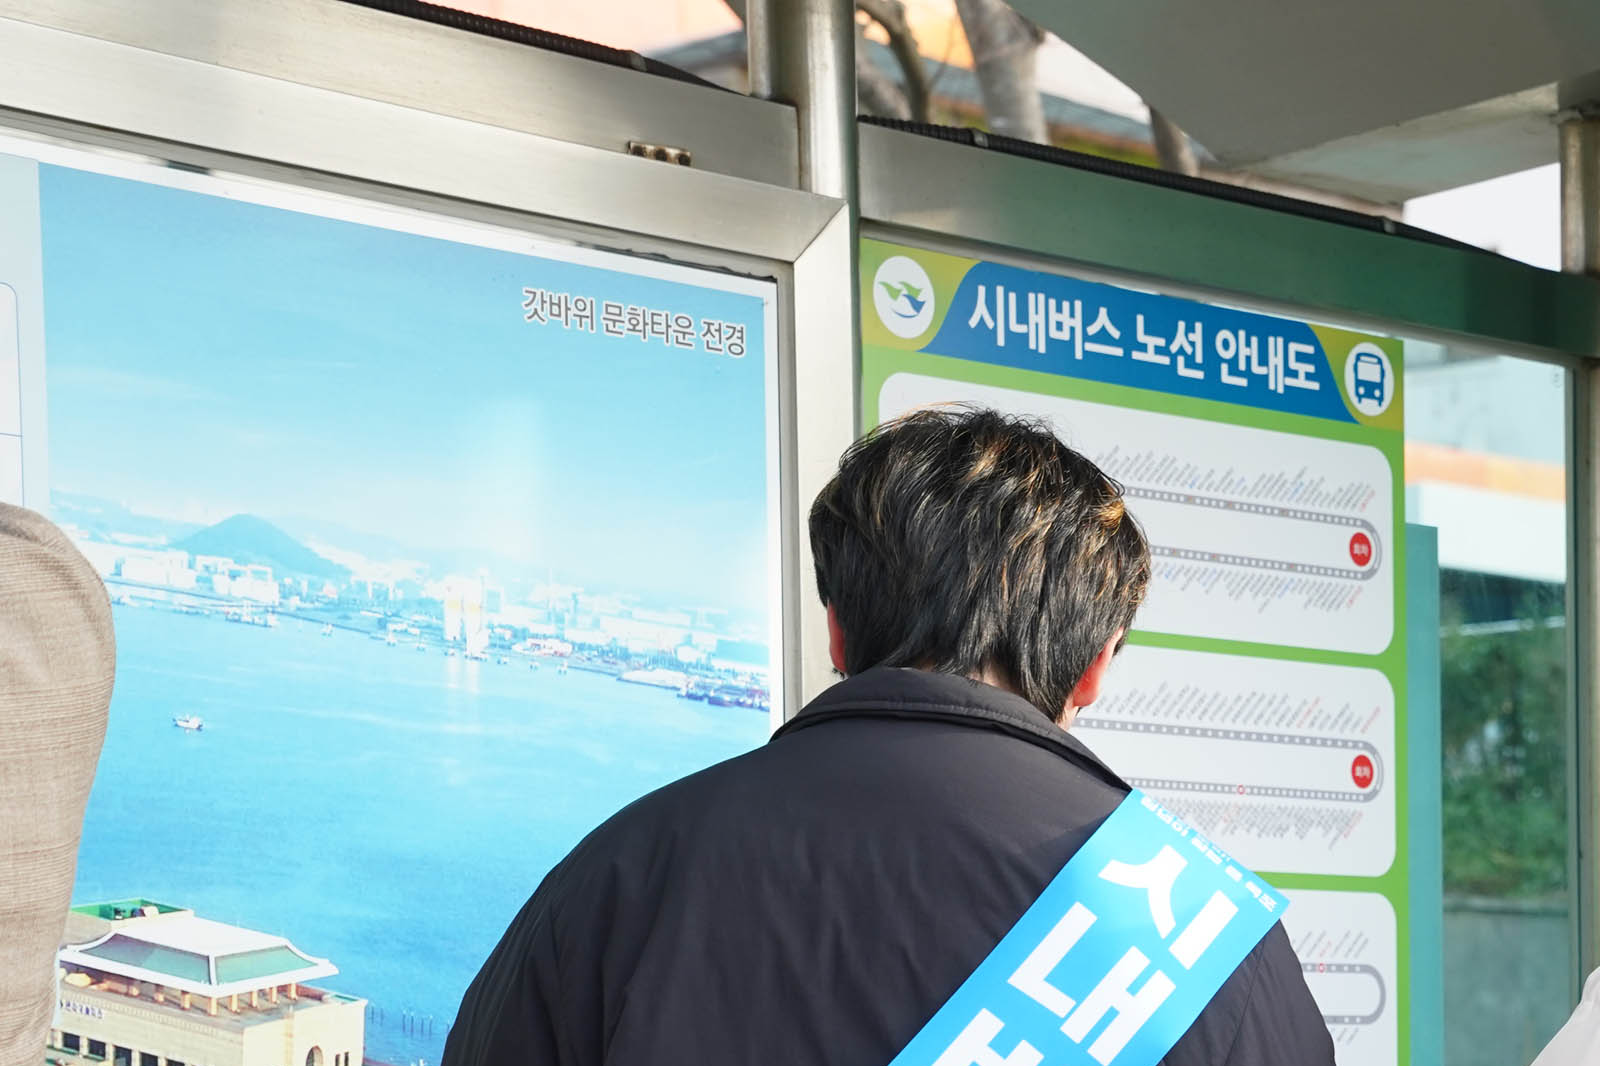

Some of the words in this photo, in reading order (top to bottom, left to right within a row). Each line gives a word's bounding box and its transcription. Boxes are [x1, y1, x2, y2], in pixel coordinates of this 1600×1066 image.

[522, 287, 595, 332] 갓바위
[601, 301, 696, 349] 문화타운
[701, 319, 746, 357] 전경
[968, 284, 1124, 360] 시내버스
[1131, 314, 1205, 380] 노선
[1215, 328, 1321, 394] 안내도
